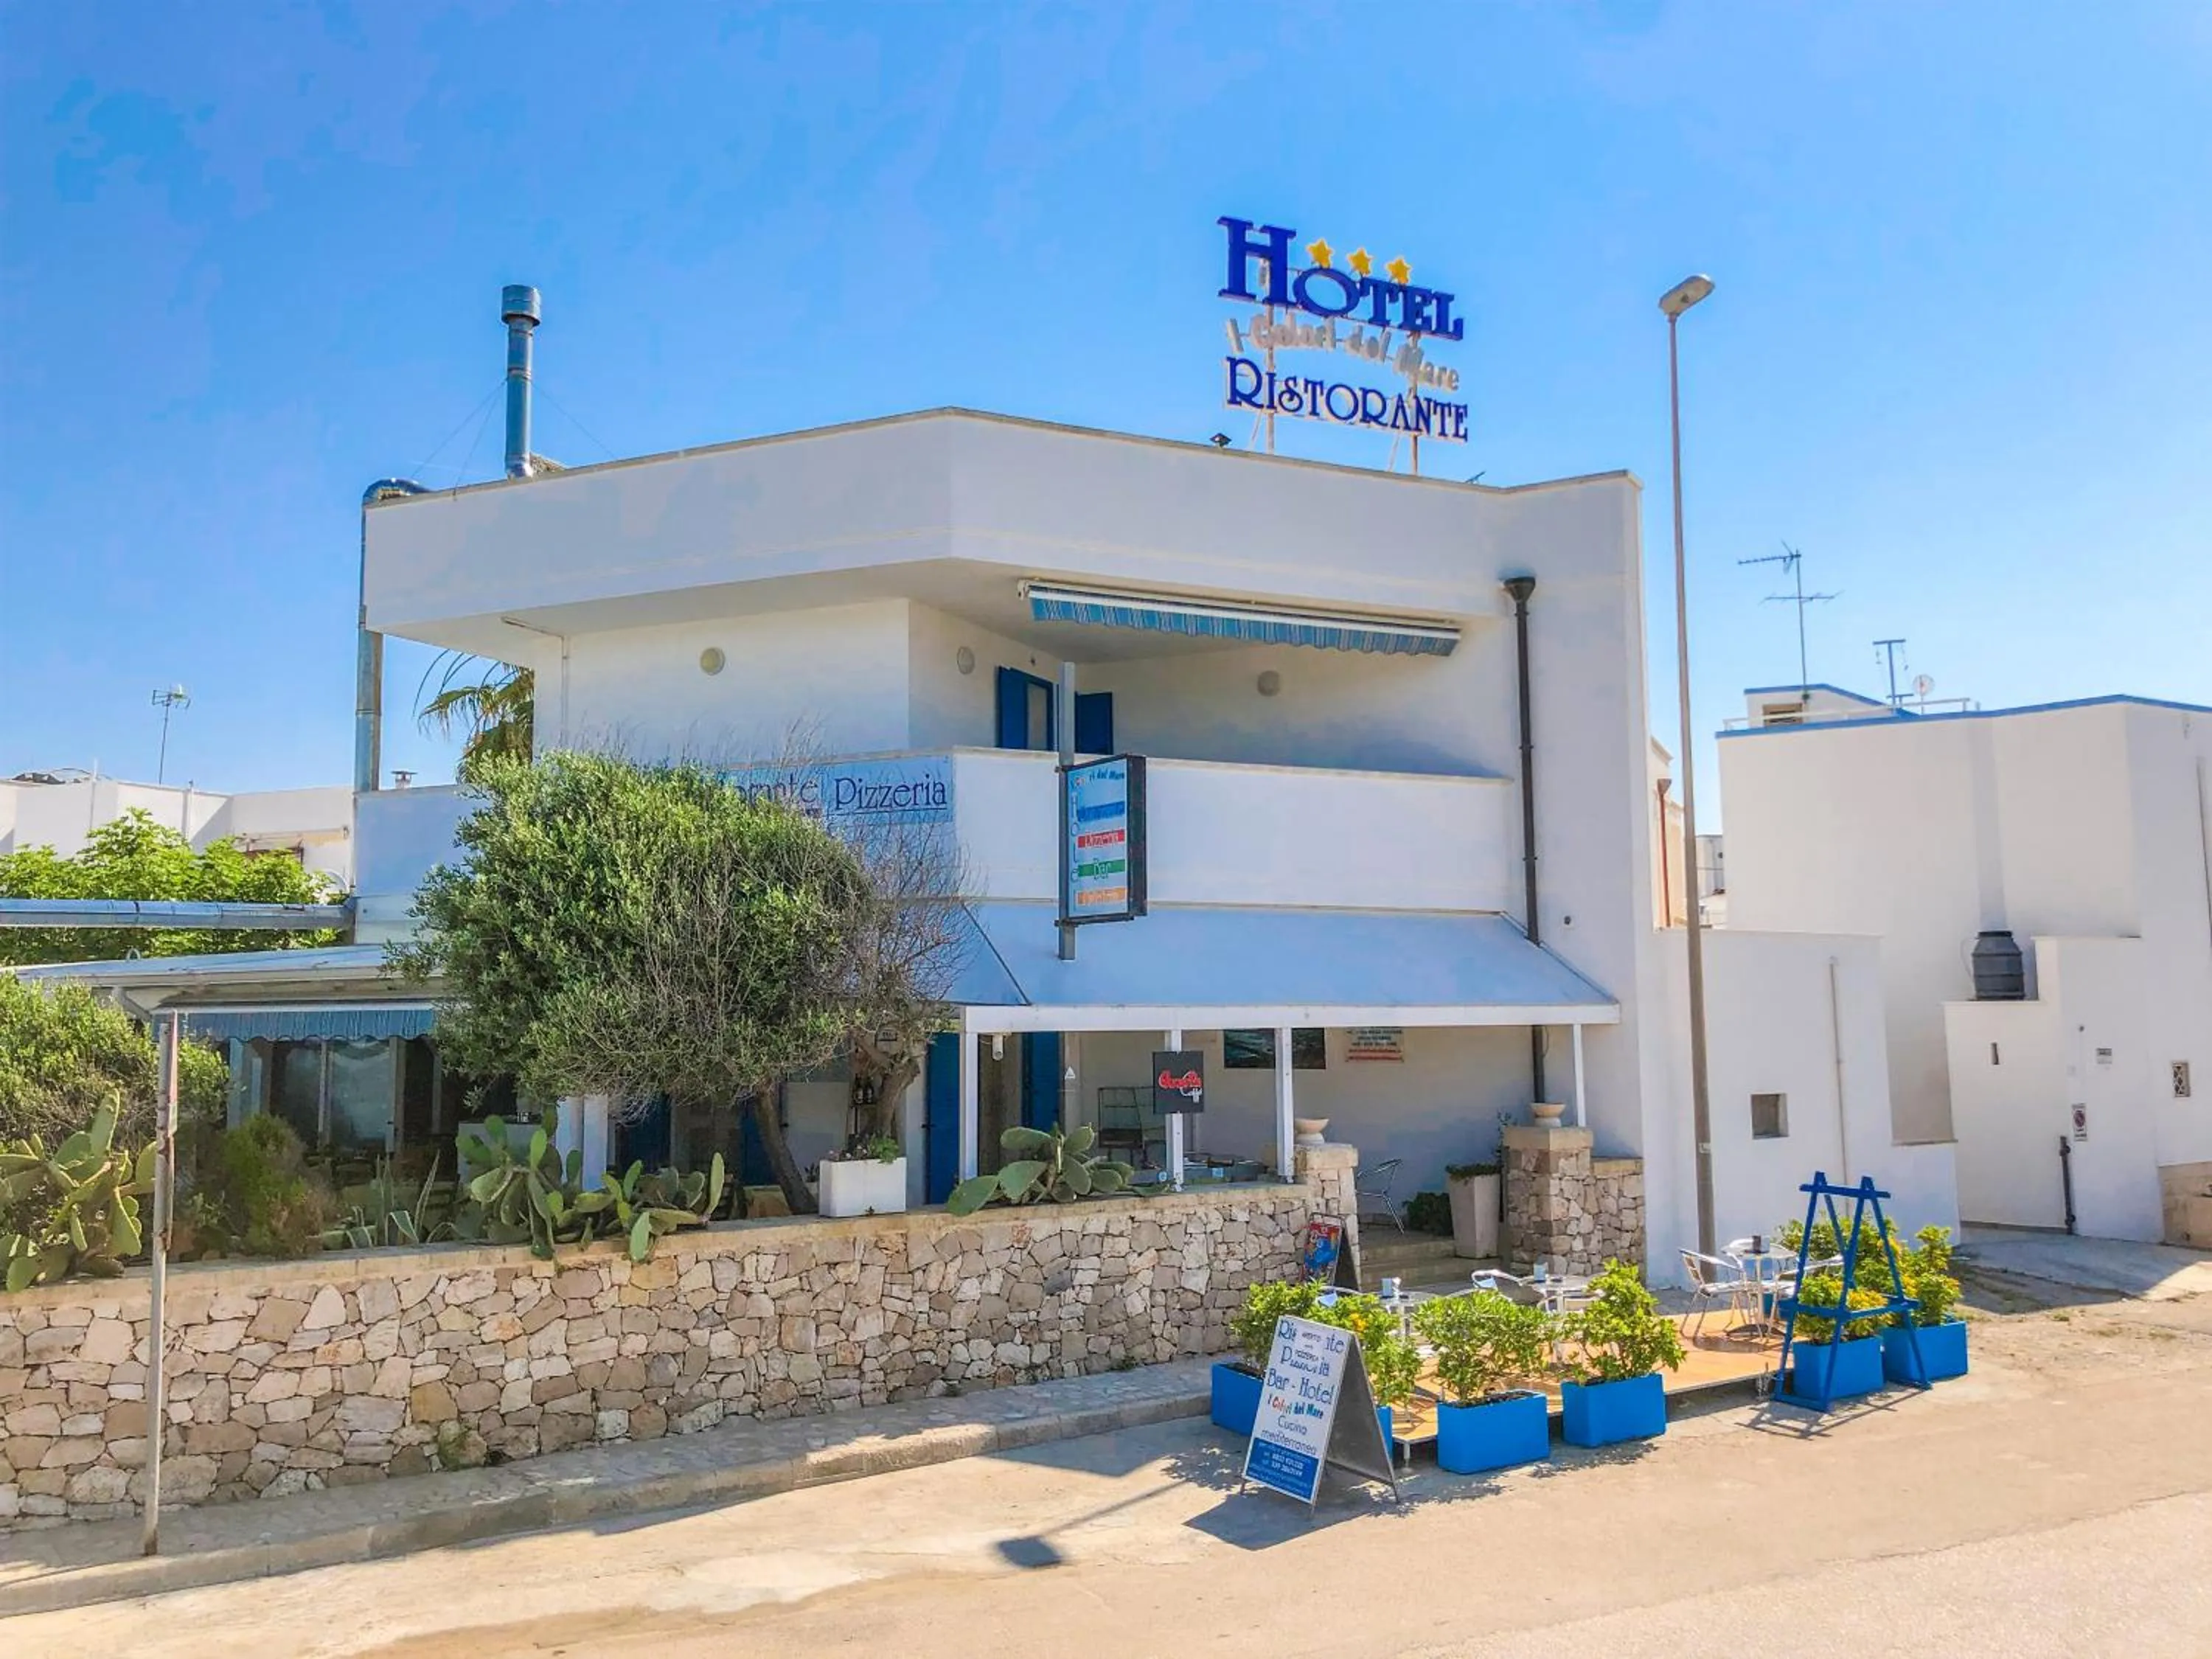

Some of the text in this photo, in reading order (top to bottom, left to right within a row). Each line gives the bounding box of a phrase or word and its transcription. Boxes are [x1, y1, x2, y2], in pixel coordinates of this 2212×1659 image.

[1217, 216, 1464, 341] HOTEL
[1223, 355, 1469, 442] RISTORANTE
[834, 773, 947, 810] Pizzeria
[1267, 1368, 1290, 1391] Bar
[1298, 1377, 1335, 1405] Hotel
